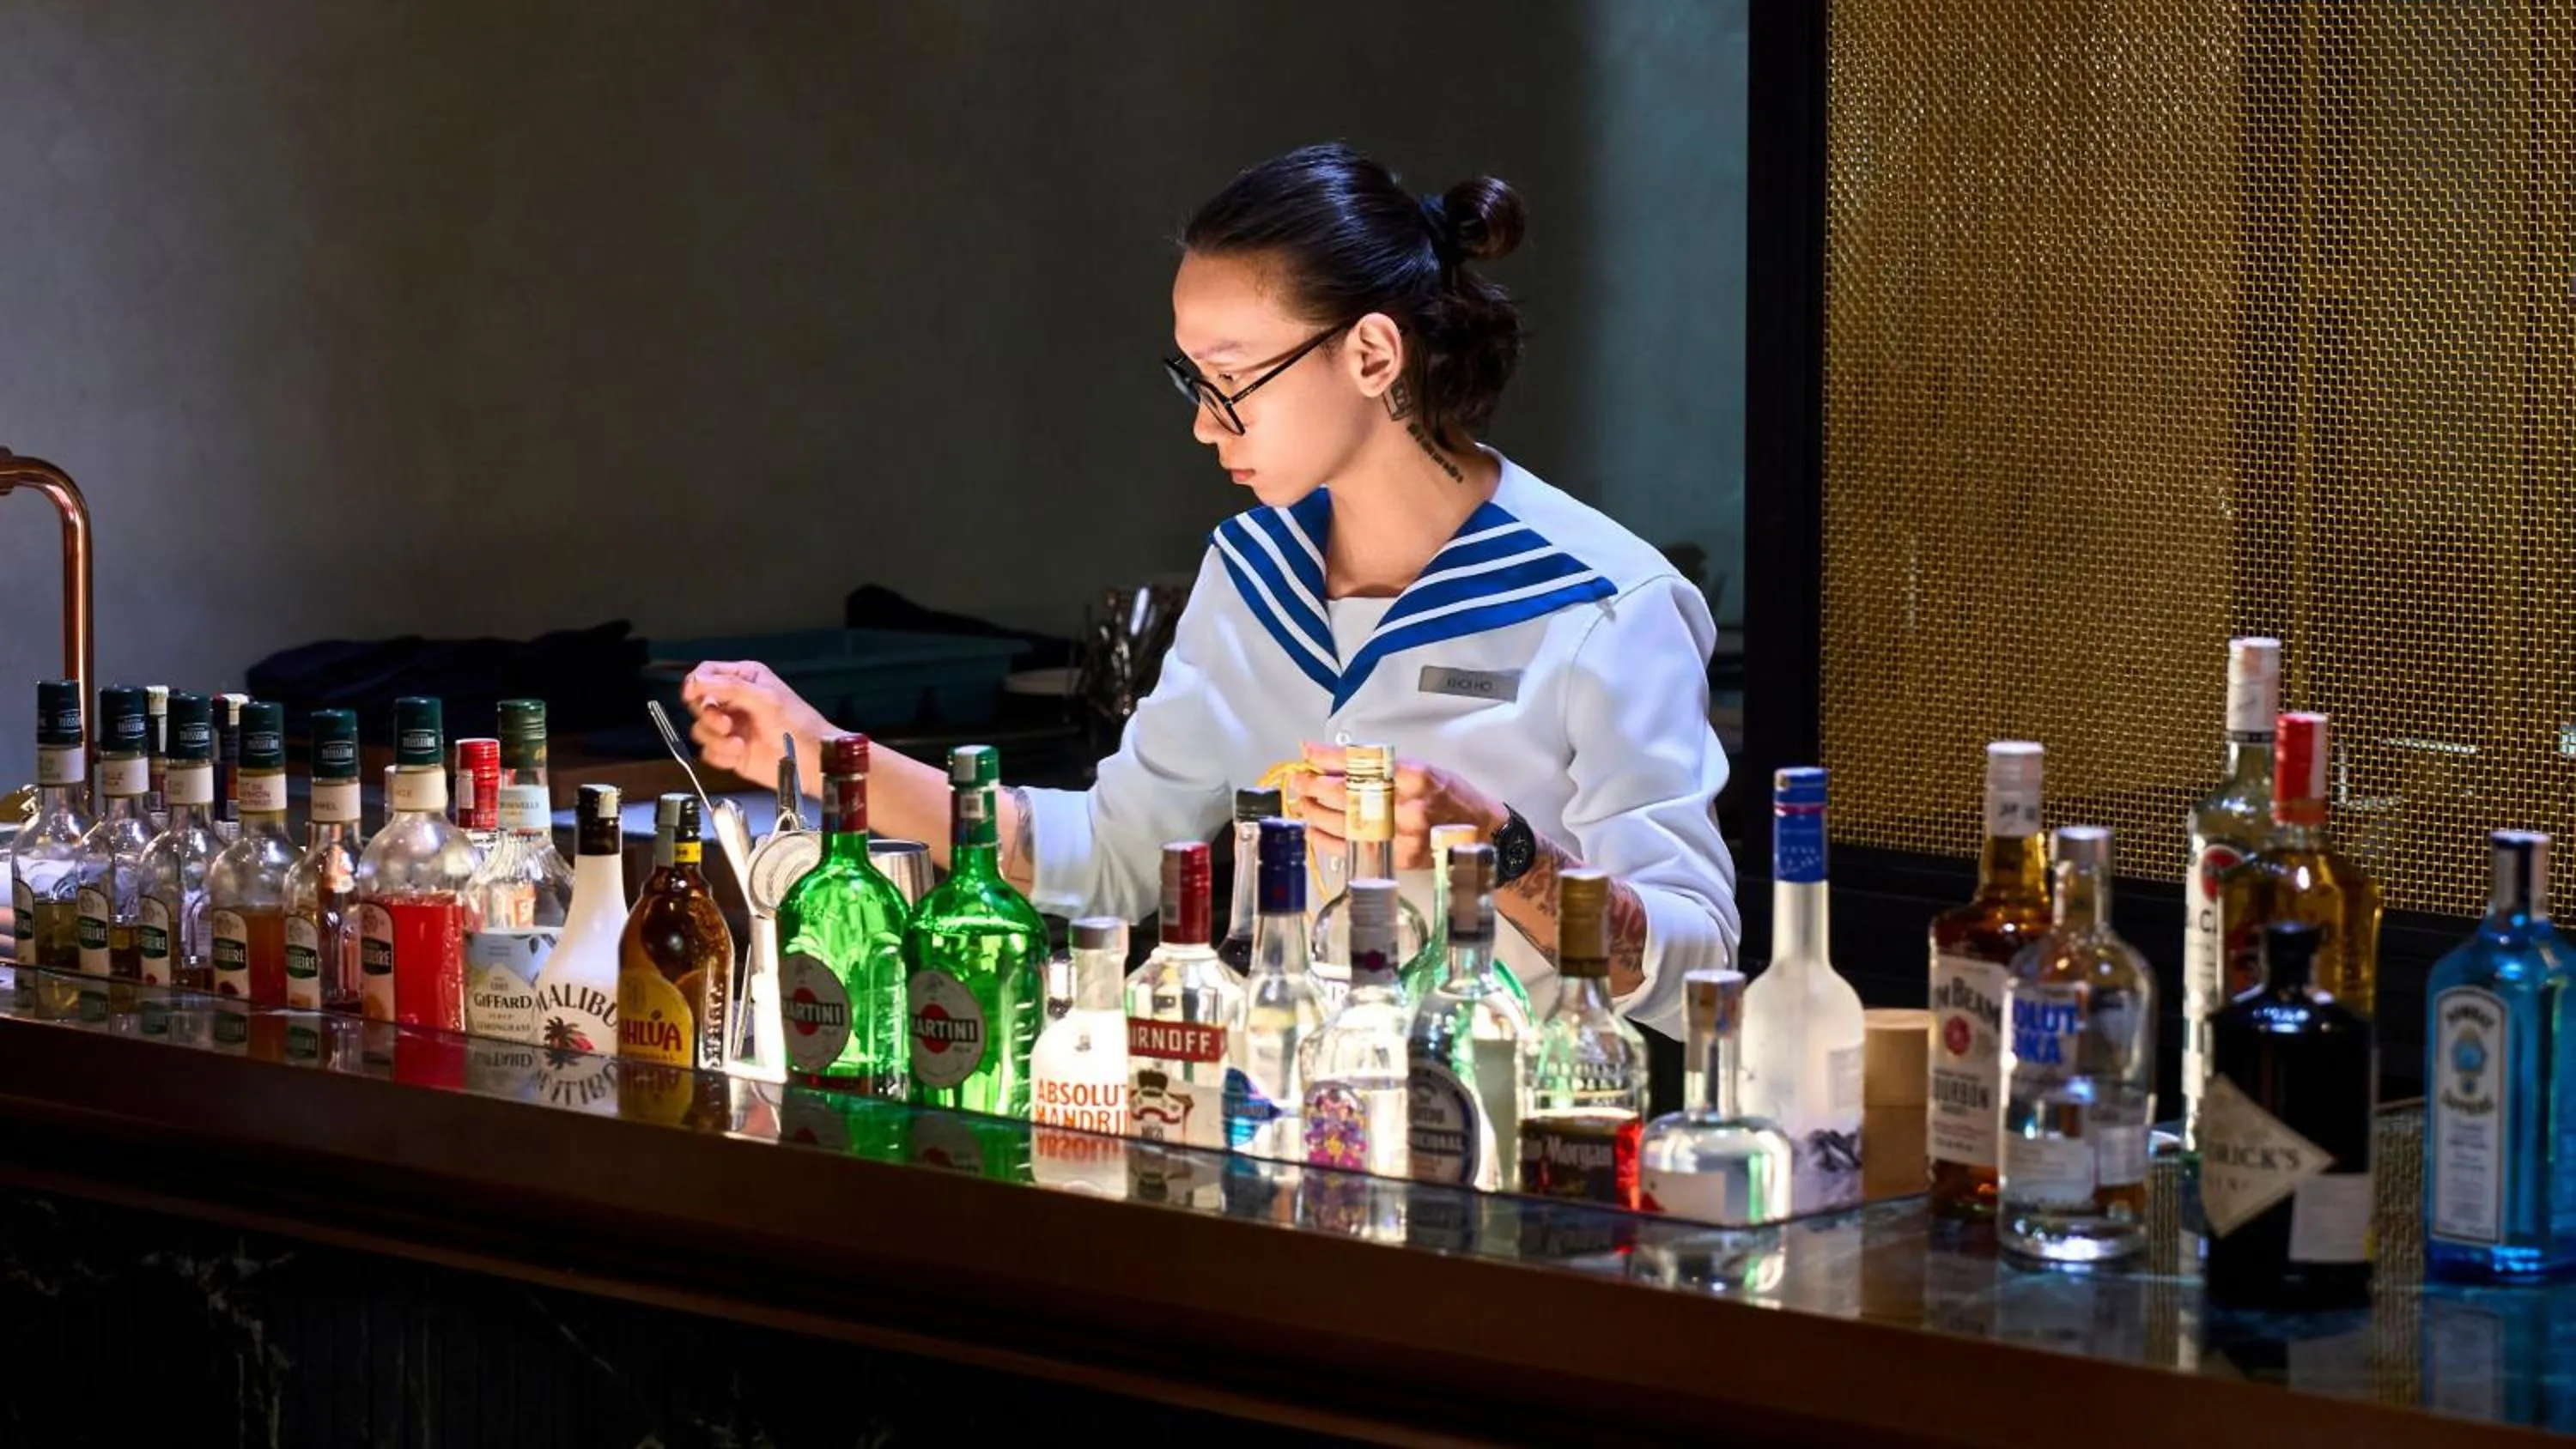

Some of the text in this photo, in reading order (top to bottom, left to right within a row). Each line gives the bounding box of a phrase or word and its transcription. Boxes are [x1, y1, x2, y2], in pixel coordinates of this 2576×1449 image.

[474, 992, 532, 1009] GIFFARD
[535, 982, 617, 1028] MALIBU
[1131, 1026, 1212, 1054] IRNOFF
